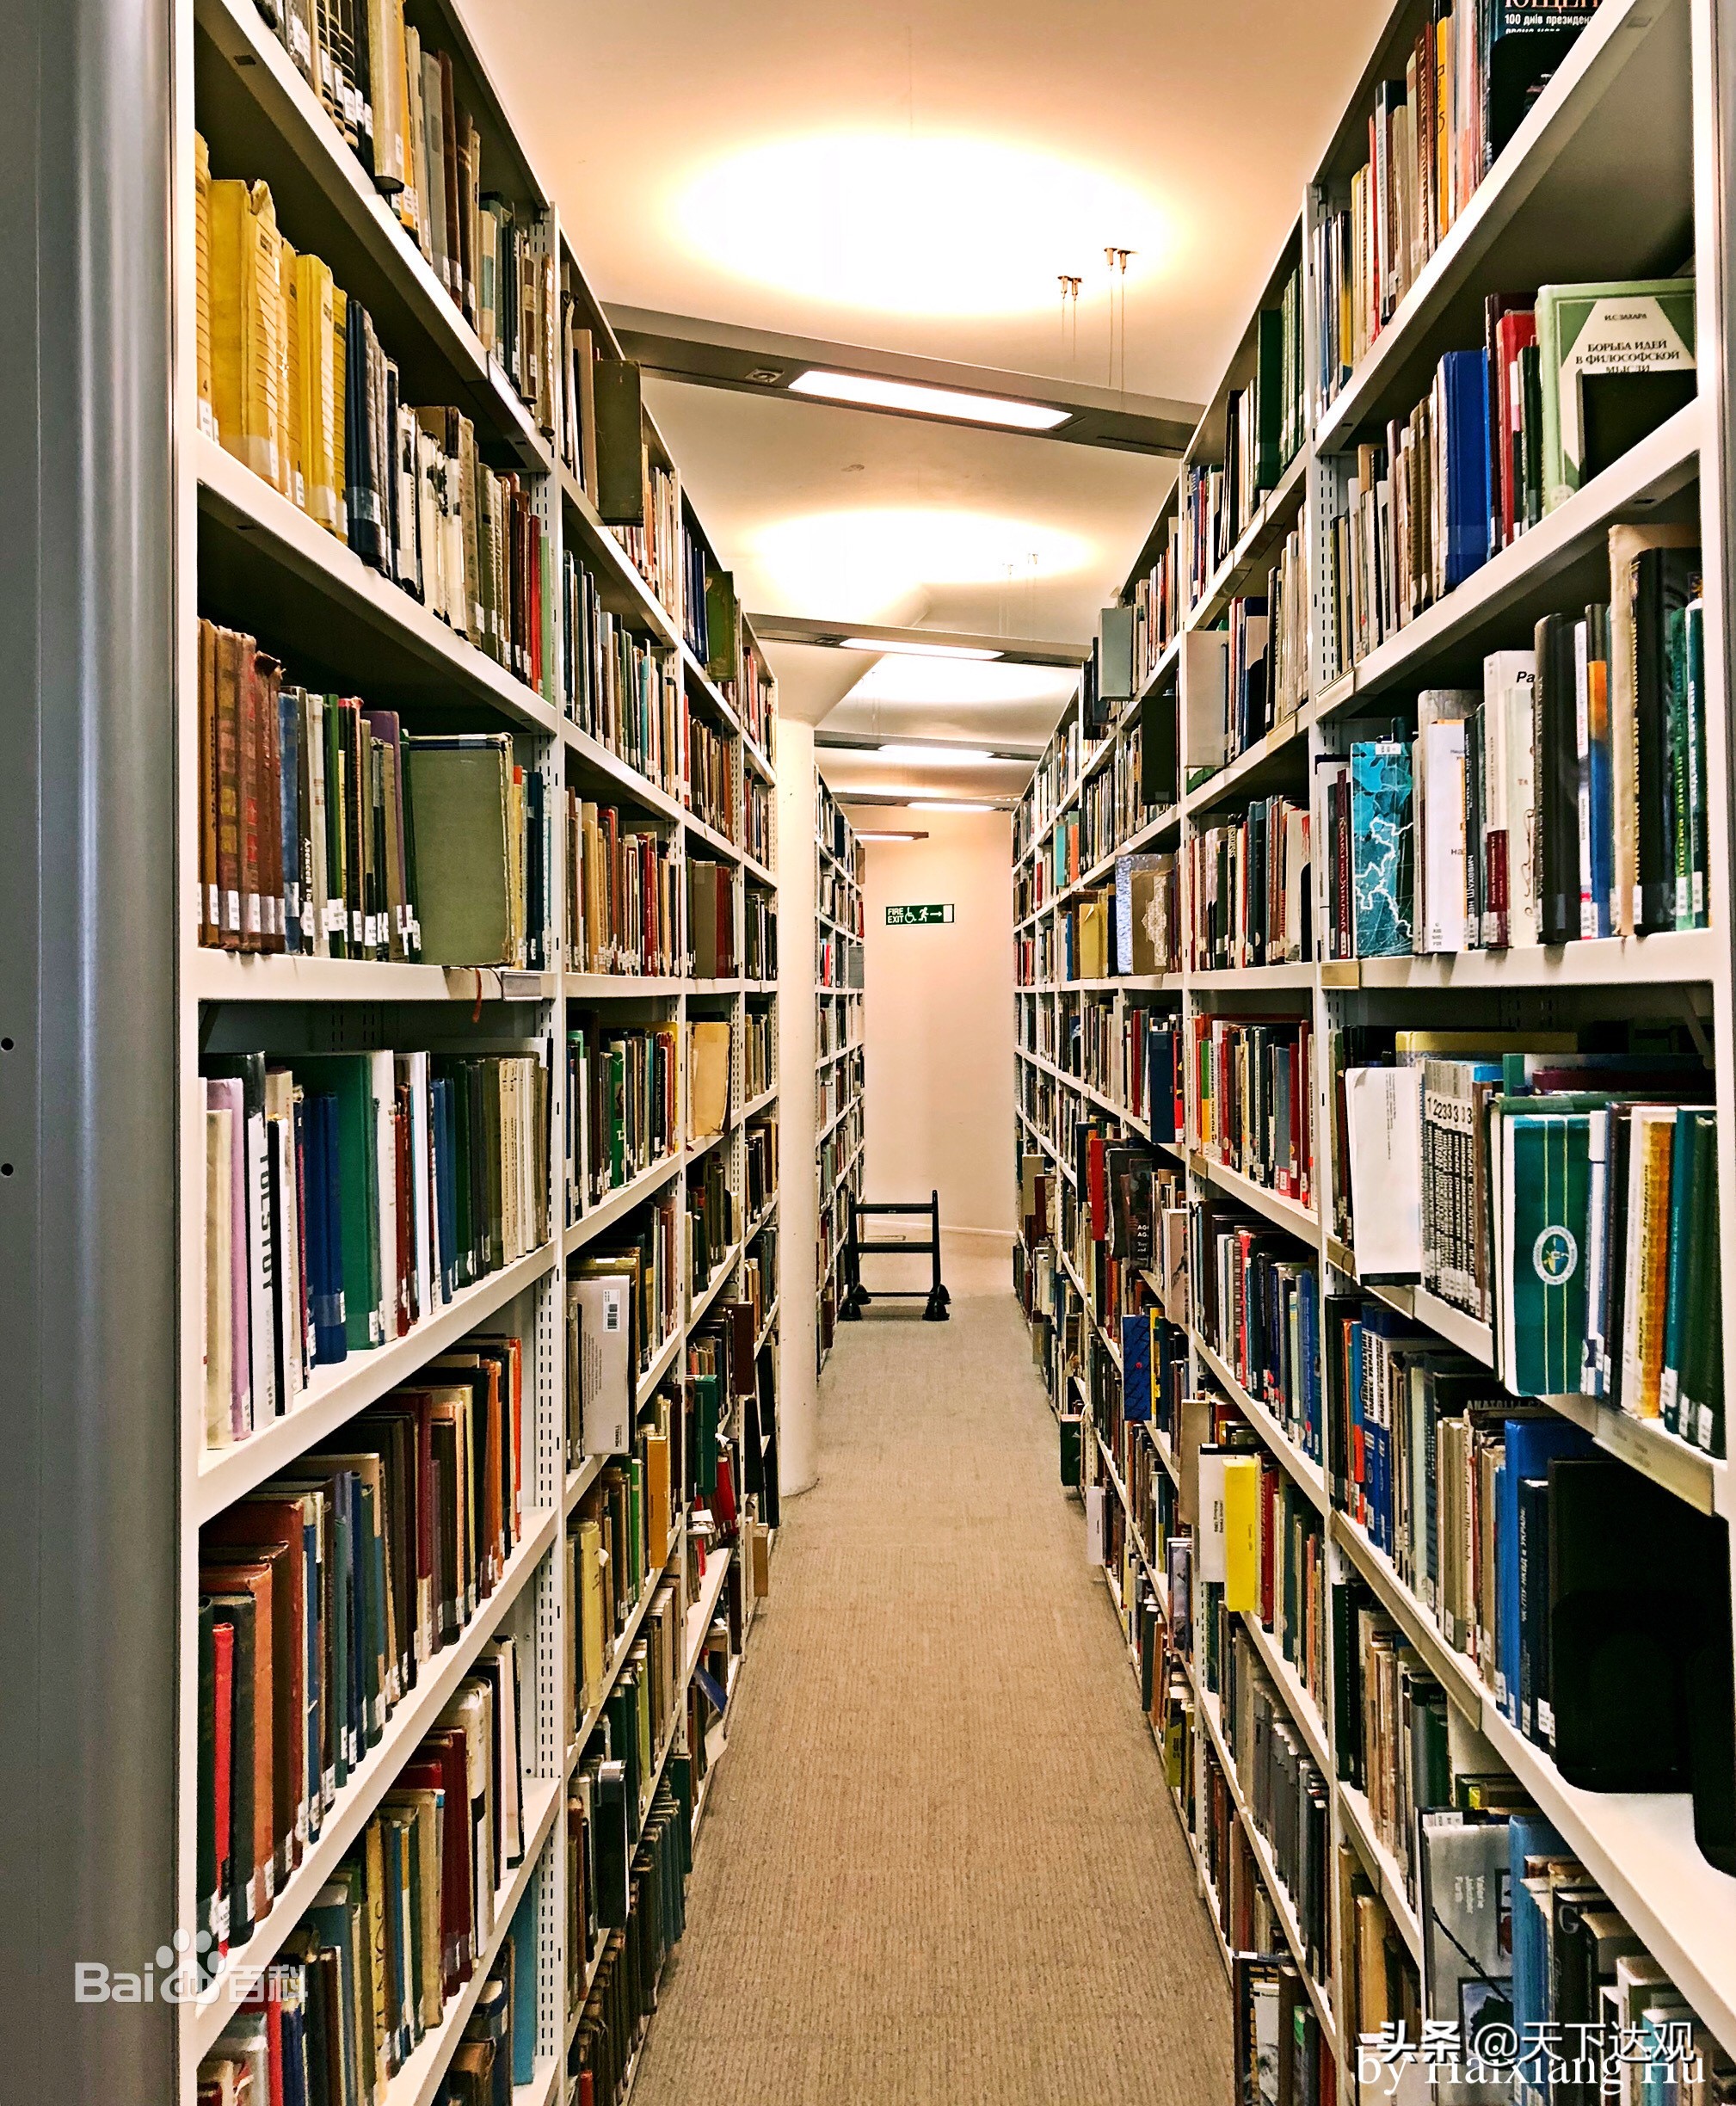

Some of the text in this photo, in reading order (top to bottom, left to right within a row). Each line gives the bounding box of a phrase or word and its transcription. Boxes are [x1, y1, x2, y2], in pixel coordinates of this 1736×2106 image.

[1505, 14, 1521, 24] 100
[1524, 14, 1543, 26] днів
[1587, 338, 1667, 353] БОРЬБА ИДЕЙ
[1576, 351, 1680, 365] В ФИЛОСОФСКОЙ
